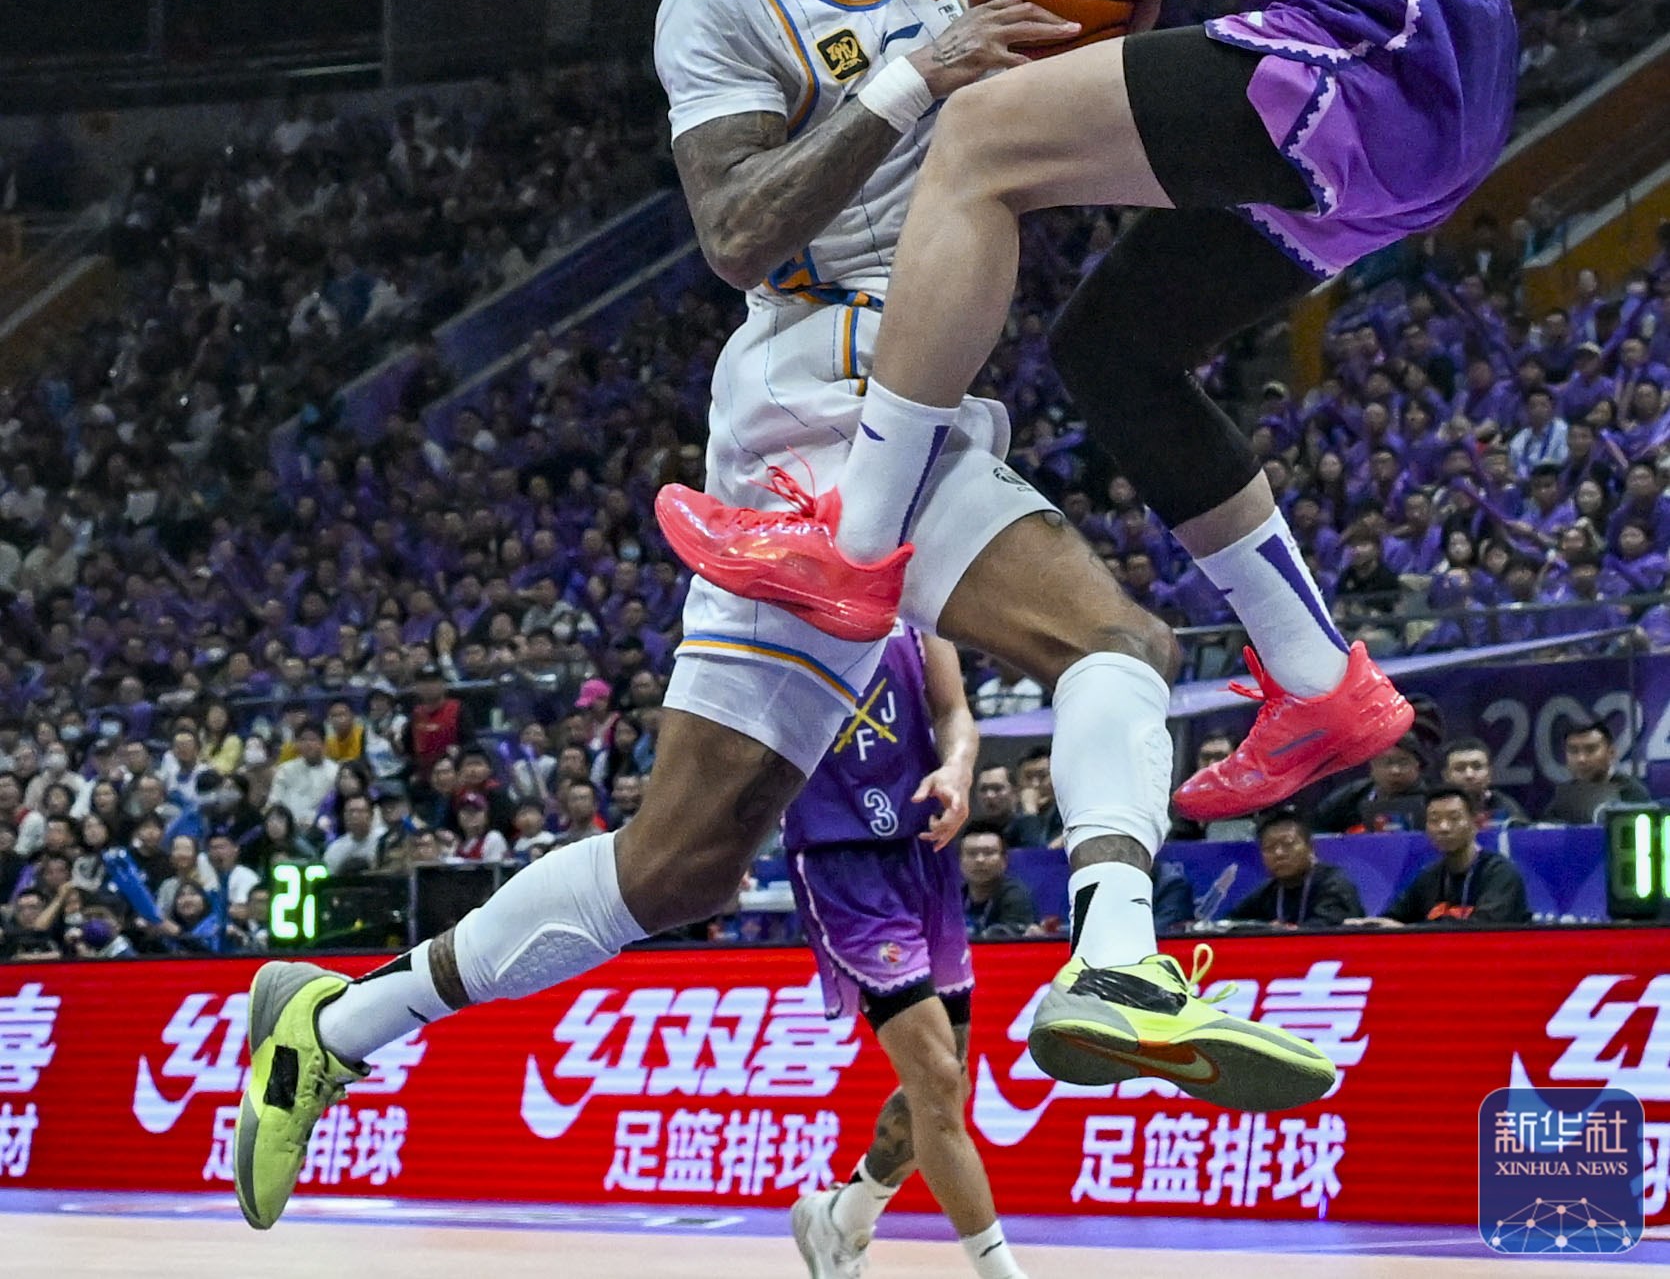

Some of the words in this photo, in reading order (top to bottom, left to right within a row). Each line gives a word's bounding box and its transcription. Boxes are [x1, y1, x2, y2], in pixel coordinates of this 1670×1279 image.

[863, 788, 899, 837] 3
[552, 971, 862, 1097] 红双喜
[603, 1107, 840, 1197] 足篮排球
[1070, 1111, 1347, 1208] 足篮排球
